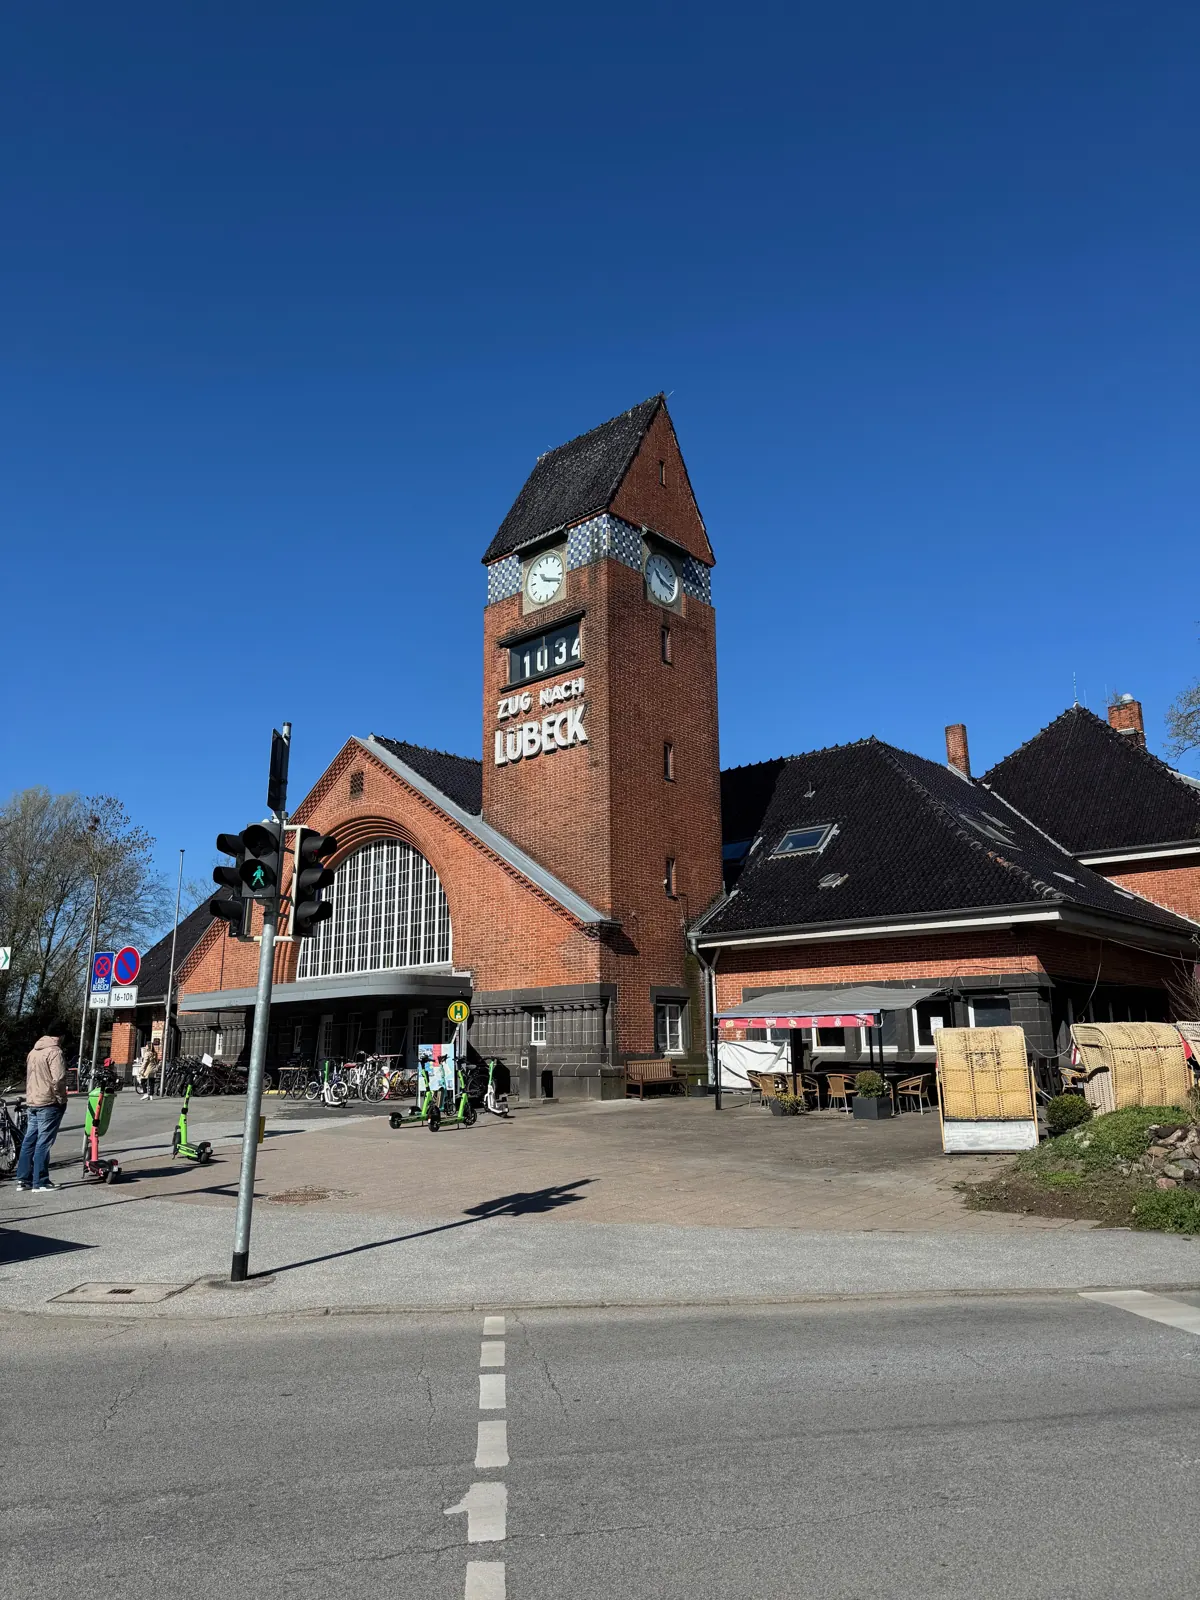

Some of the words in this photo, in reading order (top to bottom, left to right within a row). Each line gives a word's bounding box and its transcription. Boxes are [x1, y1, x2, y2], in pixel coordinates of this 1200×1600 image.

[497, 692, 532, 720] ZUG
[540, 677, 584, 706] NACH
[495, 704, 588, 765] LÜBECK
[454, 1005, 463, 1019] H
